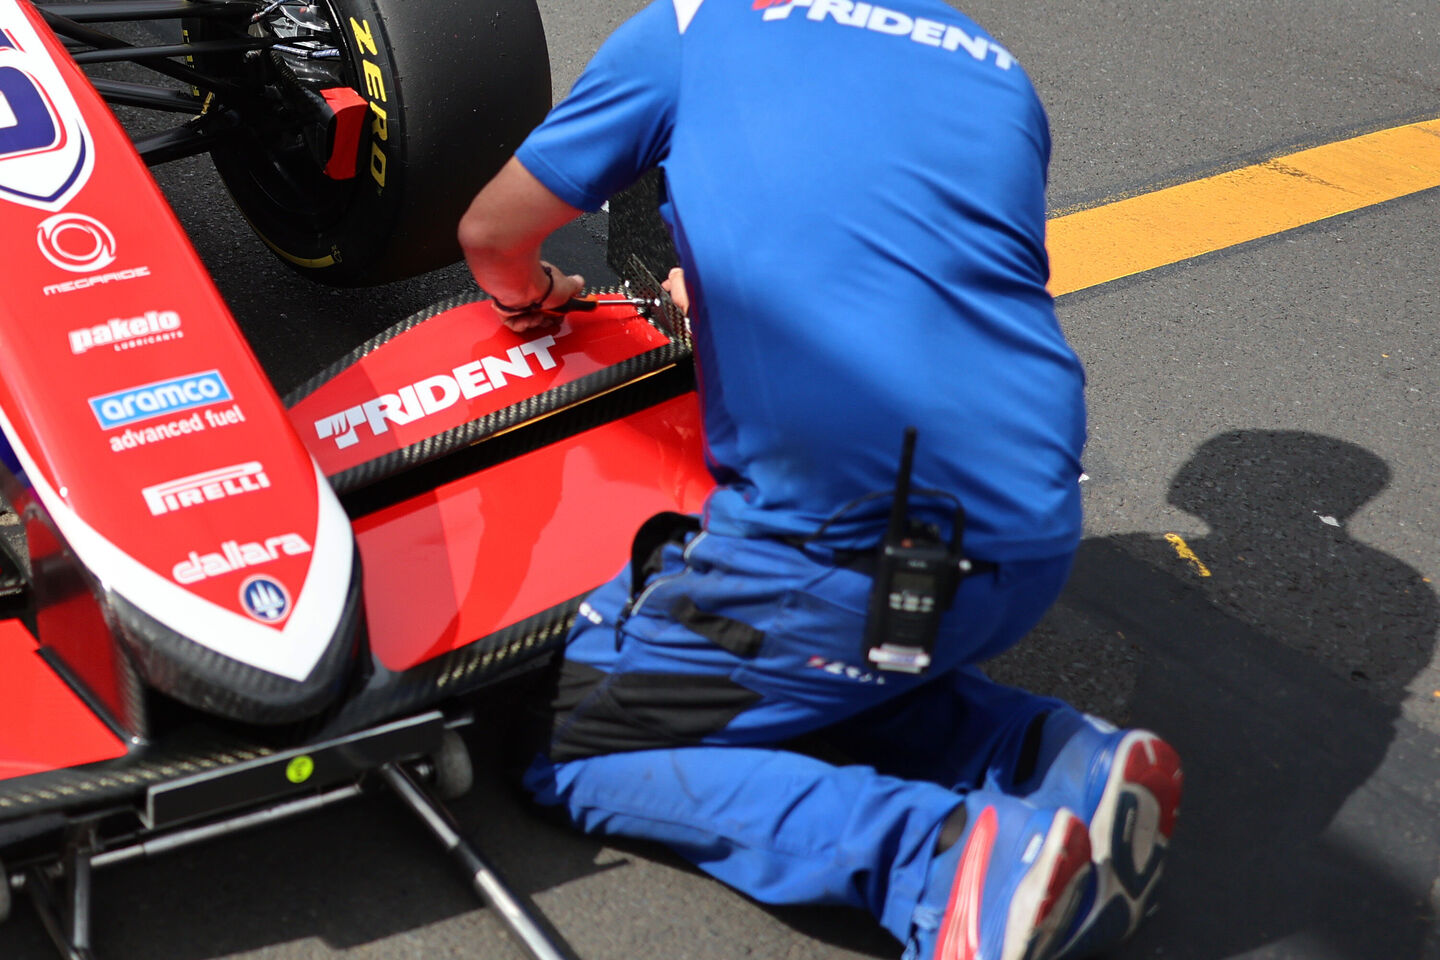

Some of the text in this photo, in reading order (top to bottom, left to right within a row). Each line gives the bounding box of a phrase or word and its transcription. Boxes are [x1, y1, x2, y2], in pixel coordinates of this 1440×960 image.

[350, 19, 389, 189] ZERO
[68, 310, 181, 354] pakelo
[114, 331, 184, 351] LUBRICANTS
[101, 377, 221, 421] aramco
[314, 334, 557, 450] TRIDENT
[109, 404, 246, 453] advanced fuel
[142, 461, 271, 517] PIRELLI
[172, 533, 312, 585] dallara
